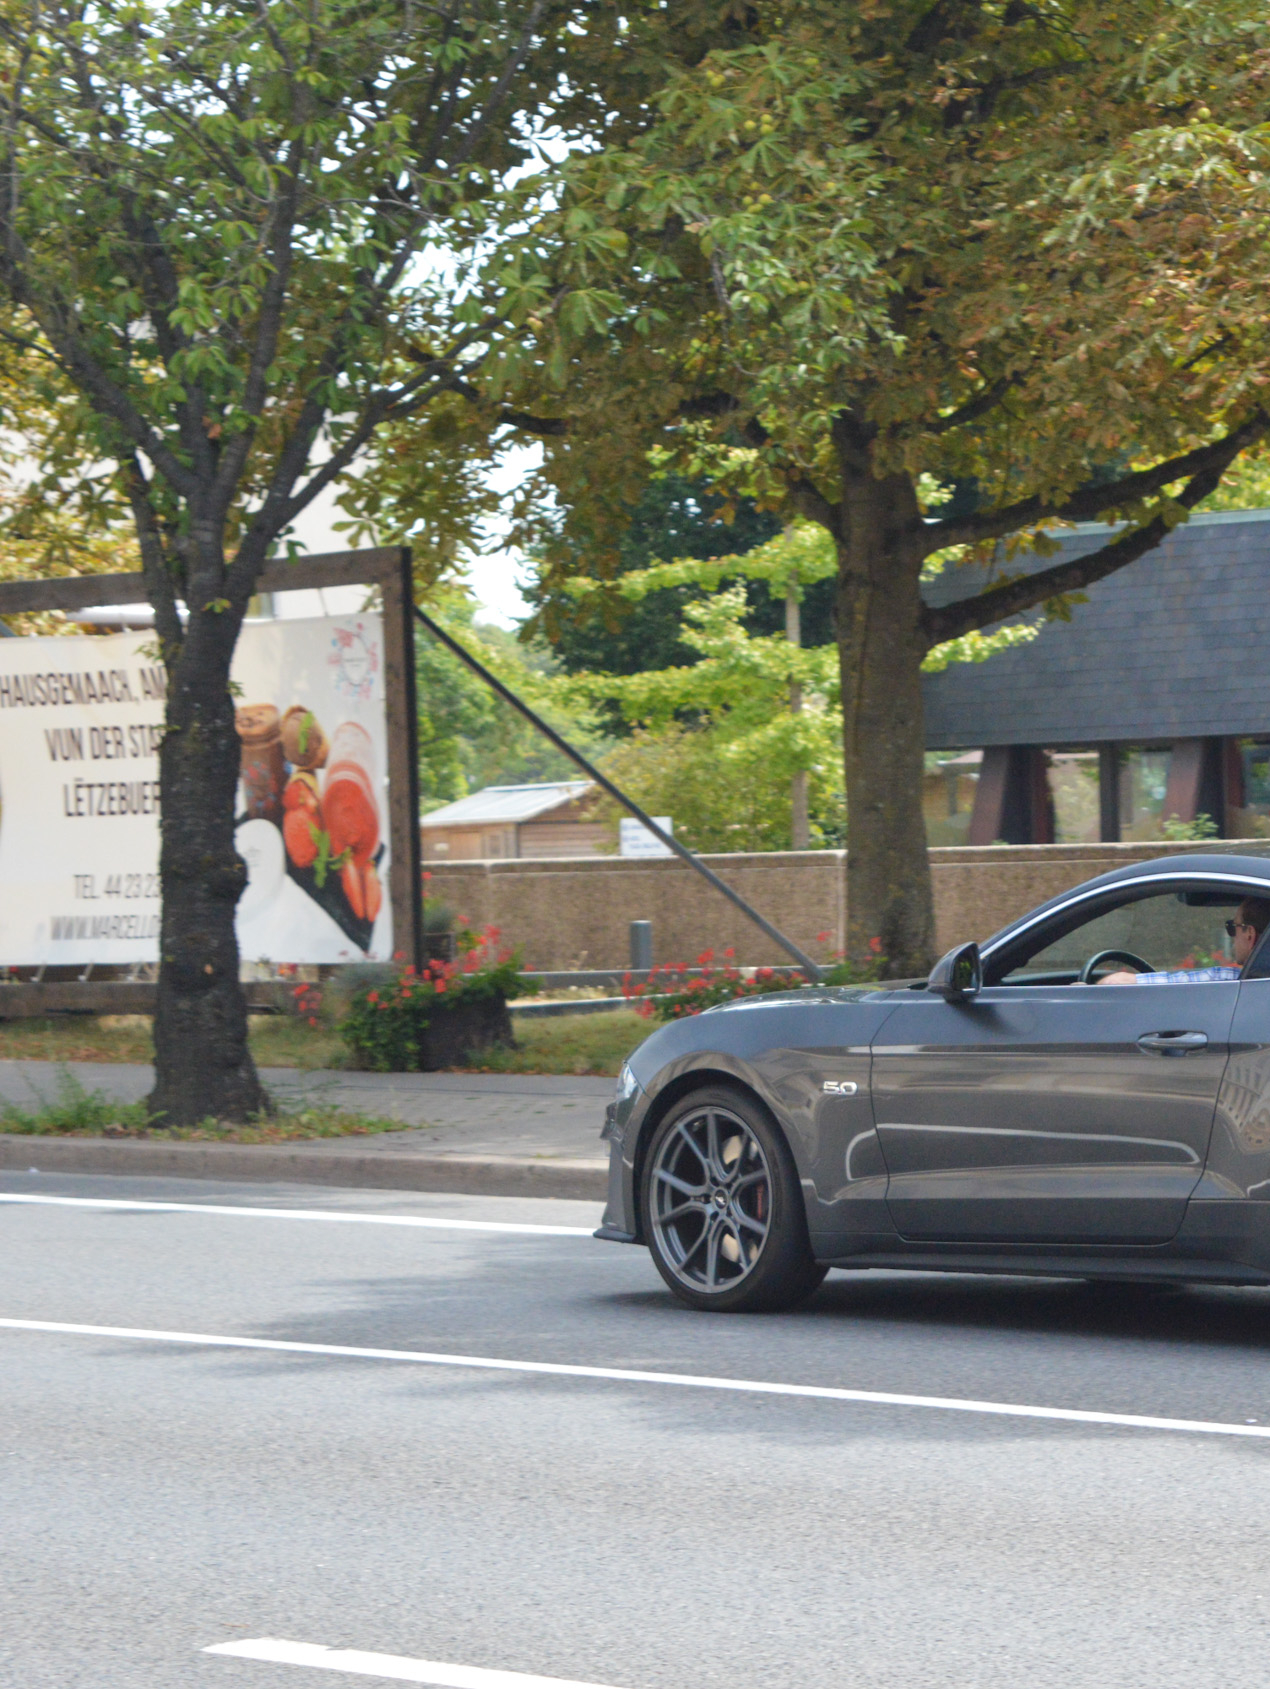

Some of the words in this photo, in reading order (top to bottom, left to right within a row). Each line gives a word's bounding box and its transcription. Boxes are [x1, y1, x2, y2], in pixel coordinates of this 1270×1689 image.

[44, 727, 84, 761] VUN
[90, 726, 126, 759] DER
[129, 725, 162, 757] STA
[63, 777, 160, 816] LËTZEBUER
[104, 874, 121, 899] 44
